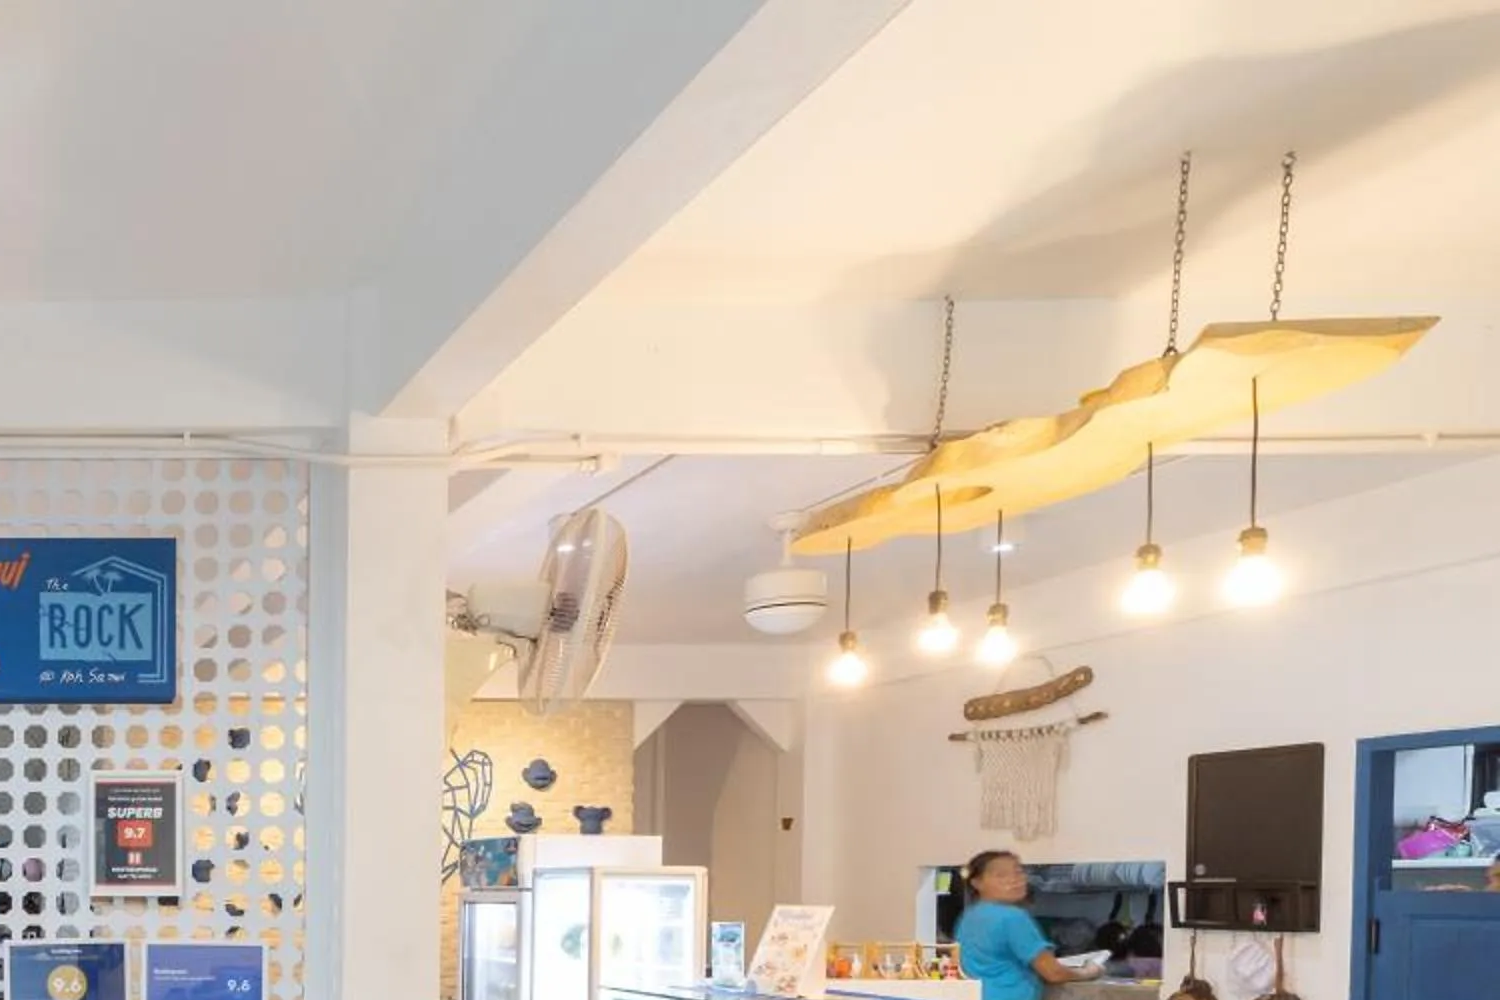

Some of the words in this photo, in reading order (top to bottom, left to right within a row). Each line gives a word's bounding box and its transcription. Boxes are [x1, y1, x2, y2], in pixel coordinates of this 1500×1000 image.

[49, 603, 145, 650] ROCK
[107, 807, 163, 819] SUPERB
[123, 828, 146, 839] 9.7
[52, 976, 82, 993] 9.6
[227, 979, 251, 992] 9.6
